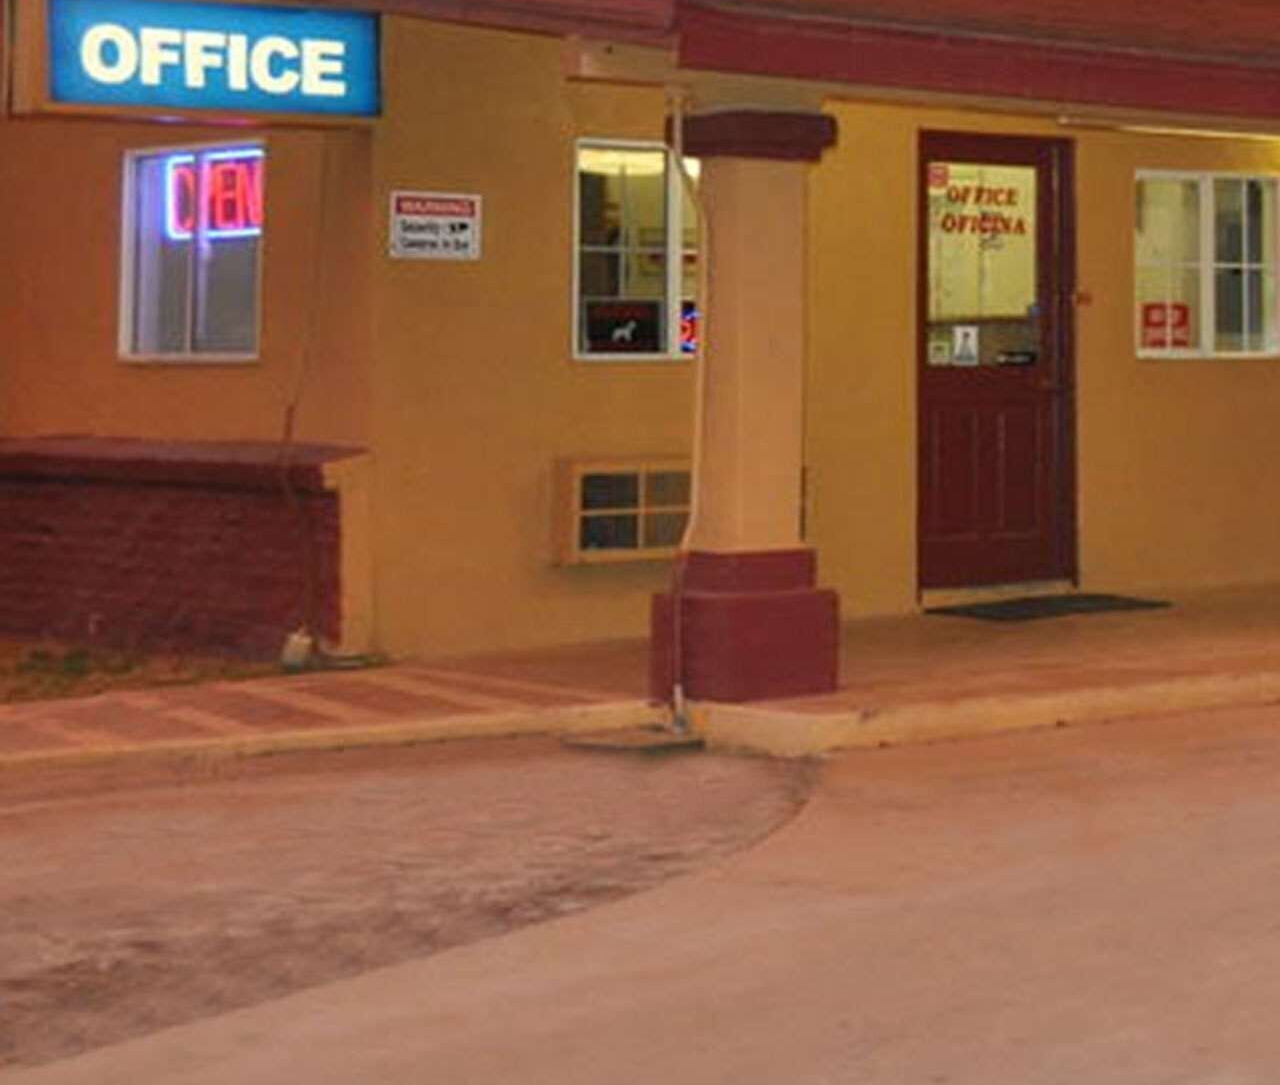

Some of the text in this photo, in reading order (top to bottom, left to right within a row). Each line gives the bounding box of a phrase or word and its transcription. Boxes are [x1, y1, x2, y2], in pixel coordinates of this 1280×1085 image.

[80, 22, 346, 96] OFFICE
[401, 199, 472, 214] WARNING
[947, 185, 1018, 207] OFFICE
[941, 212, 1026, 234] OFICINA
